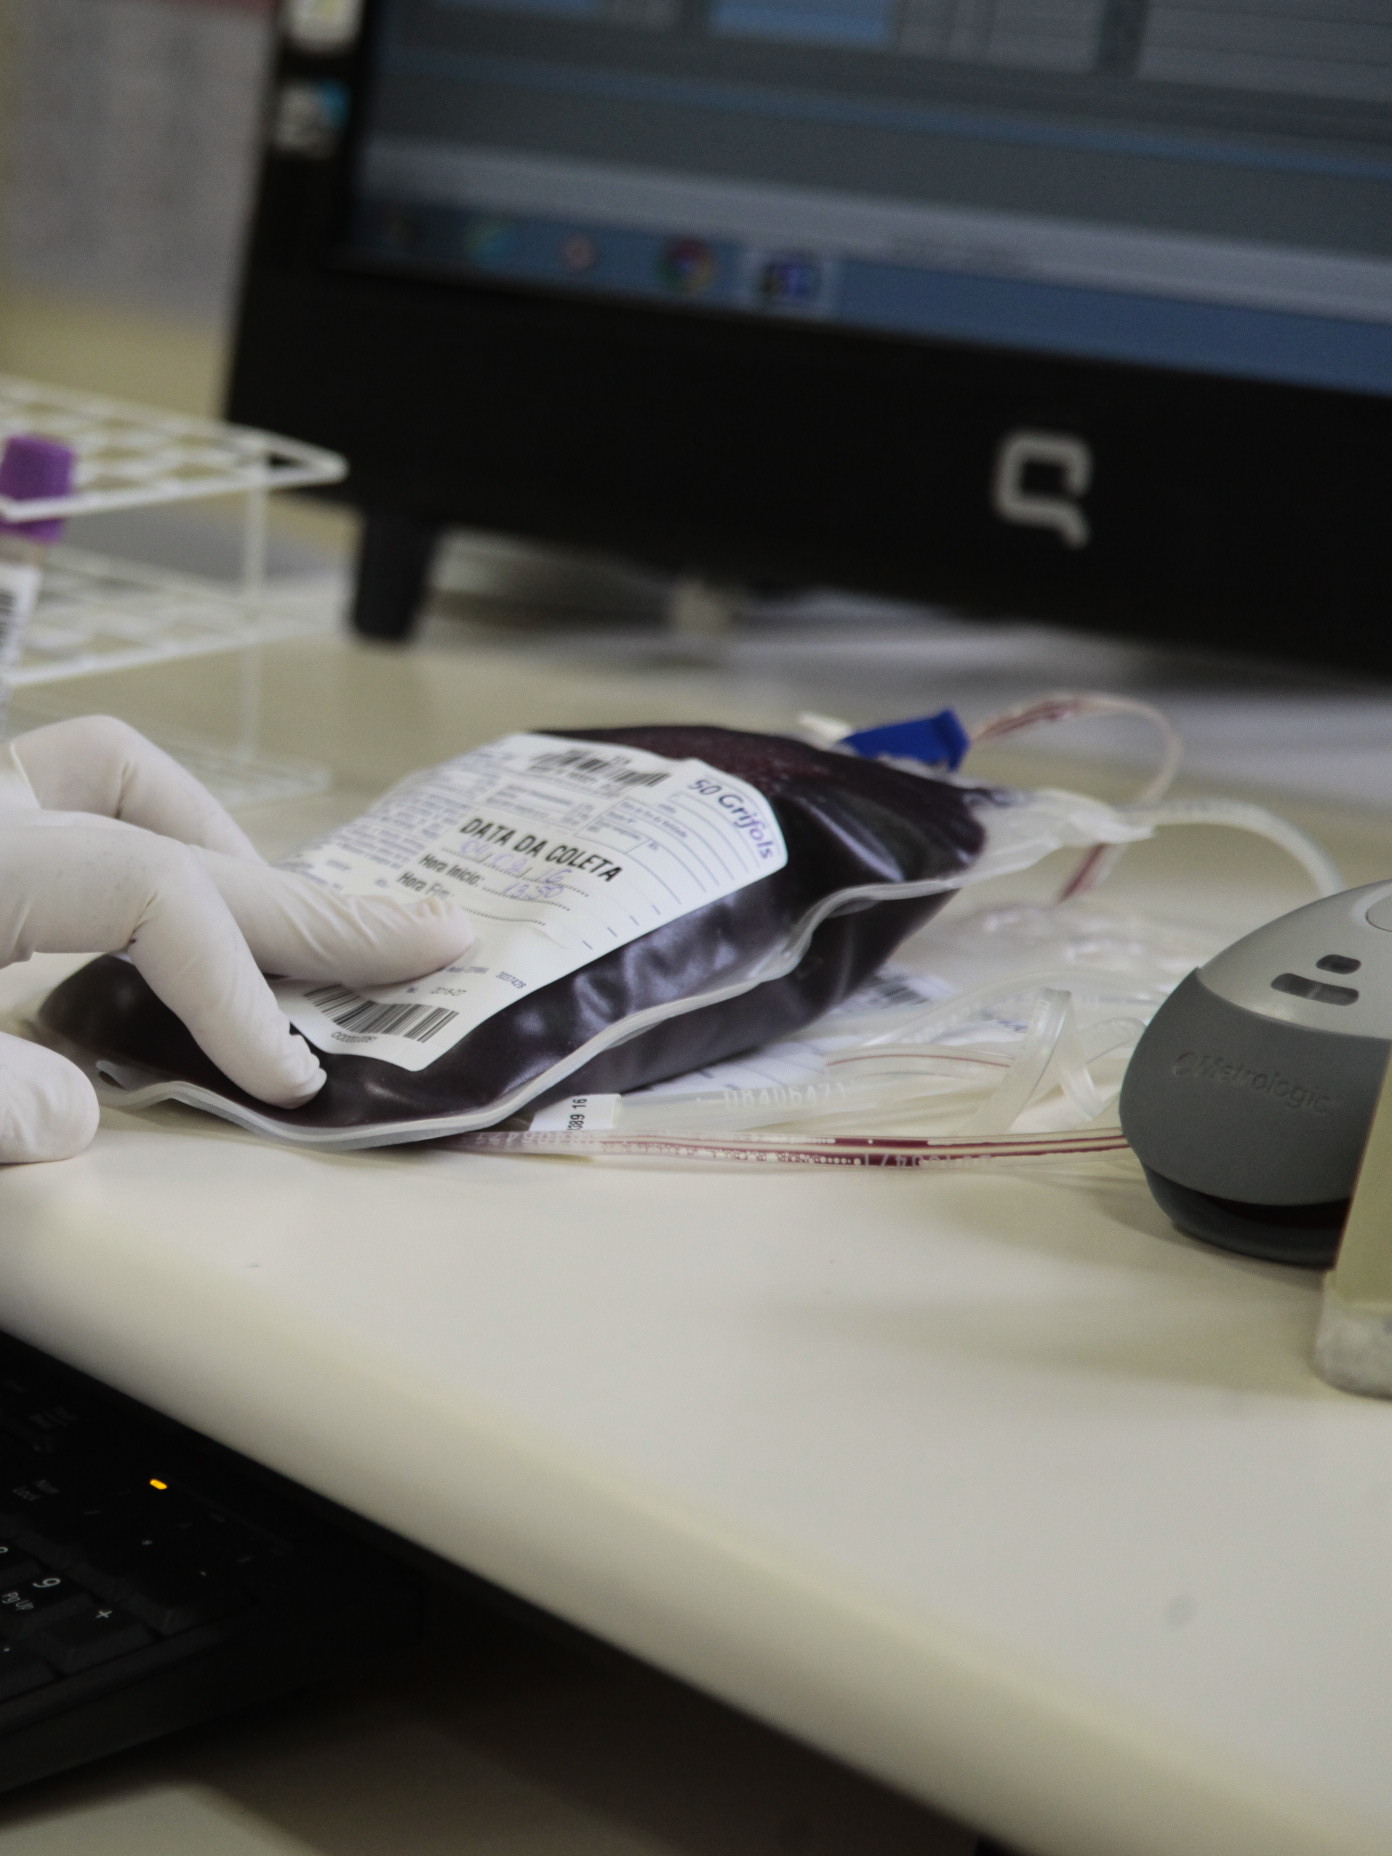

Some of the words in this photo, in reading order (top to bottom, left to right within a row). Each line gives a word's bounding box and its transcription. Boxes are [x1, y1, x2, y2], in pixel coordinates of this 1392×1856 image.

[718, 793, 773, 860] Grifols
[460, 817, 517, 847] DATA
[513, 834, 548, 858] DA
[546, 845, 623, 882] COLETA
[418, 853, 449, 873] Hora
[397, 871, 428, 893] Hora
[32, 1577, 62, 1590] 9
